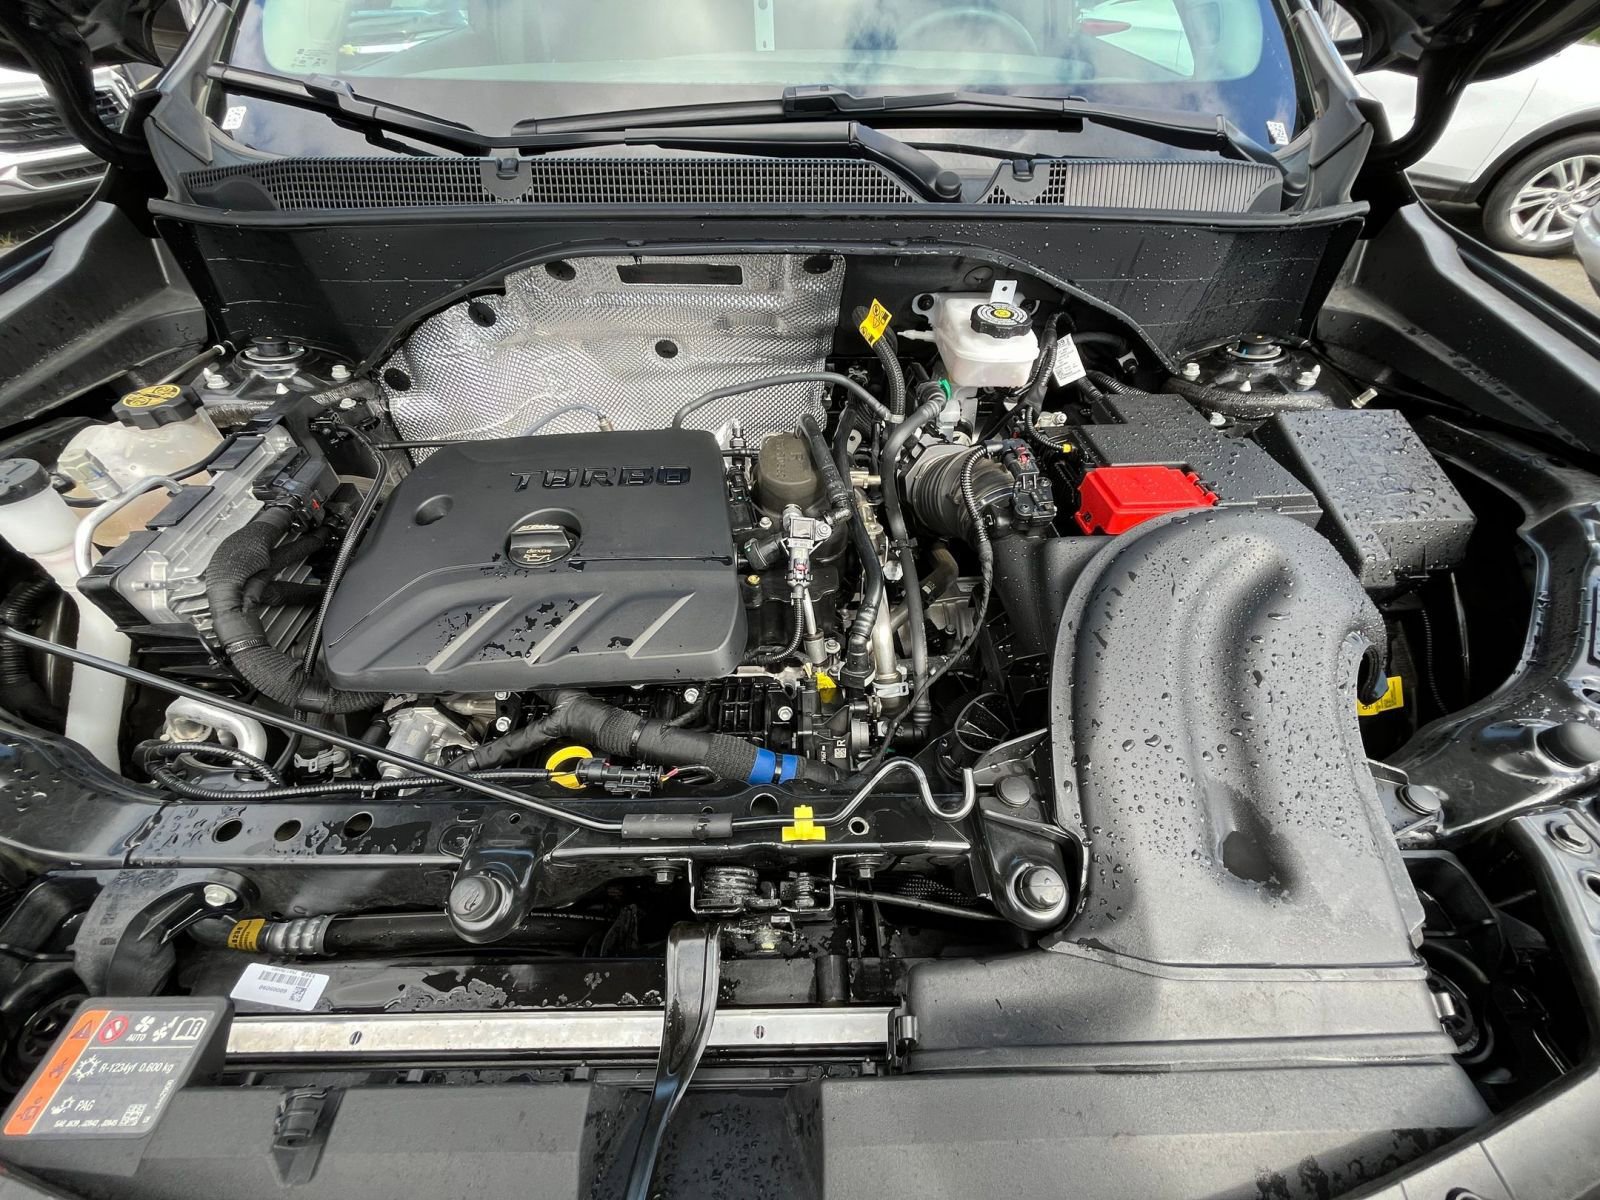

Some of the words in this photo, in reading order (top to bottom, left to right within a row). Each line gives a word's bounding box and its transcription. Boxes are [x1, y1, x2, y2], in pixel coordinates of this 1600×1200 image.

[511, 466, 692, 492] TURBO
[126, 1033, 147, 1041] AUTO
[98, 1062, 139, 1074] R-1234yf
[161, 1062, 174, 1074] kg
[74, 1099, 96, 1112] PAG
